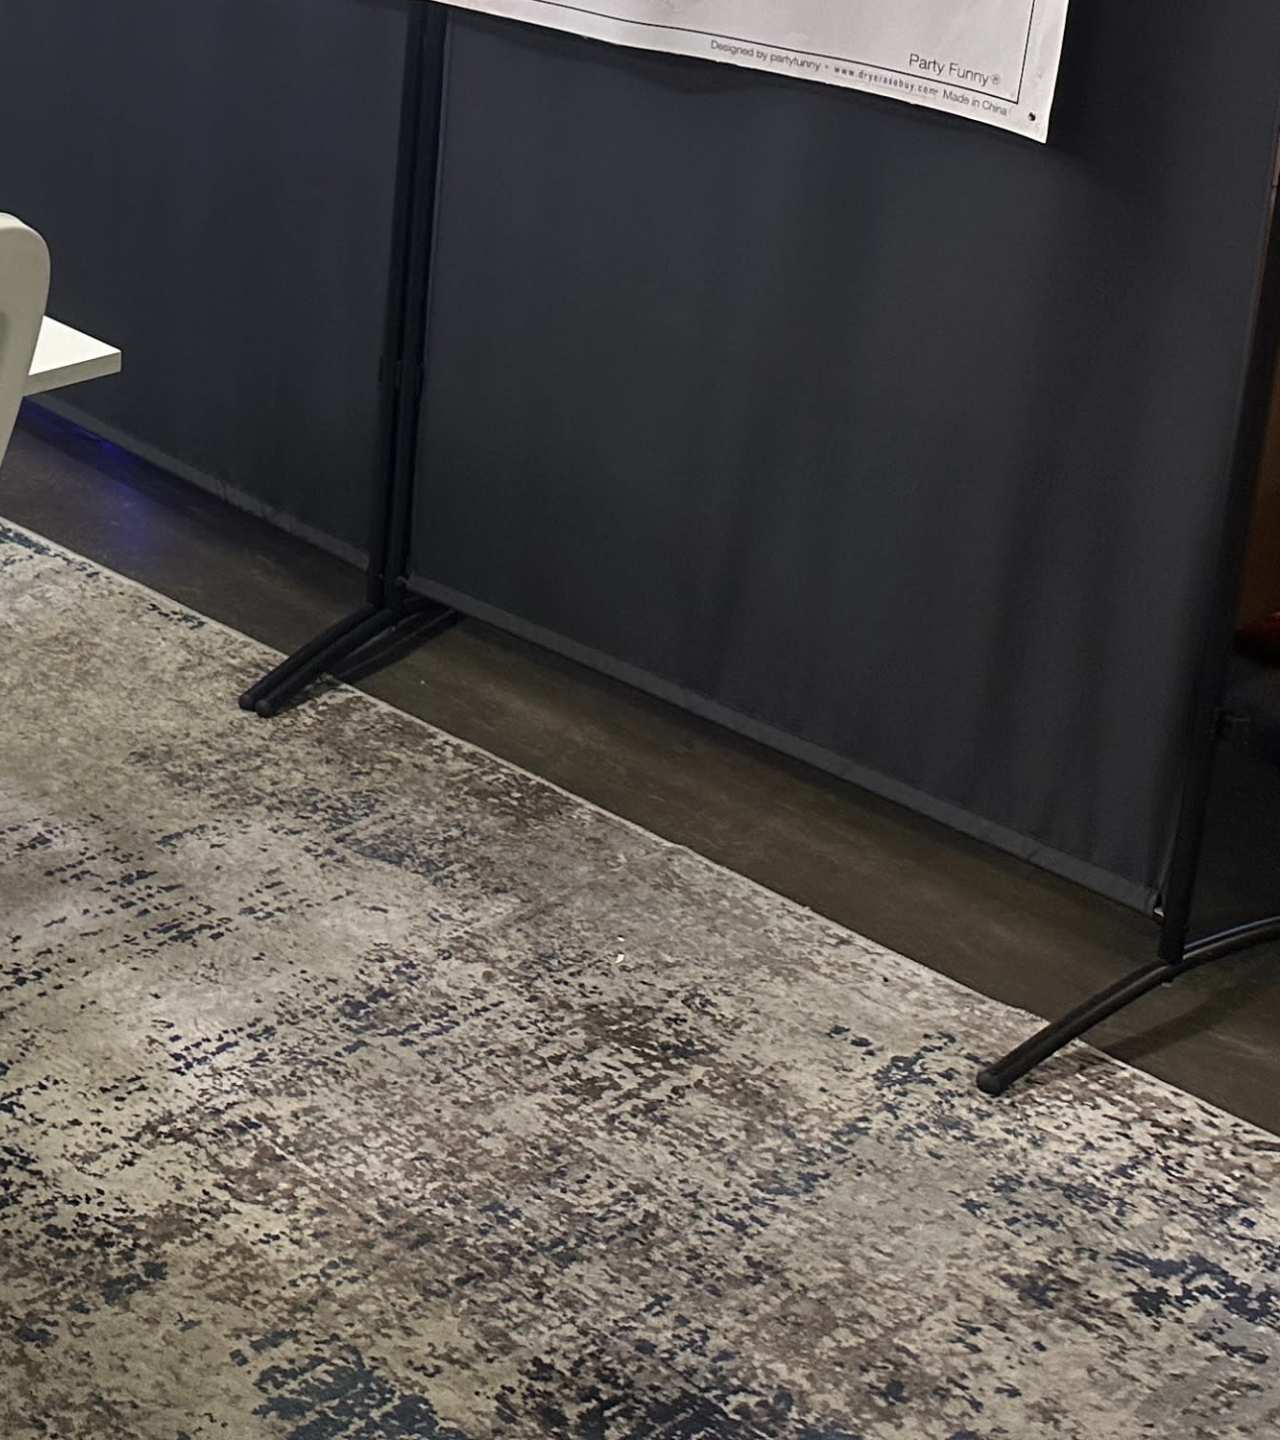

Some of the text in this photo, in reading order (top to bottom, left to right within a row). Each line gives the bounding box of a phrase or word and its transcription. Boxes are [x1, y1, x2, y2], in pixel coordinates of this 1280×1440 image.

[710, 39, 755, 57] Designed
[756, 49, 769, 62] by
[943, 88, 969, 105] Made
[981, 98, 1008, 116] China
[909, 52, 945, 76] Party
